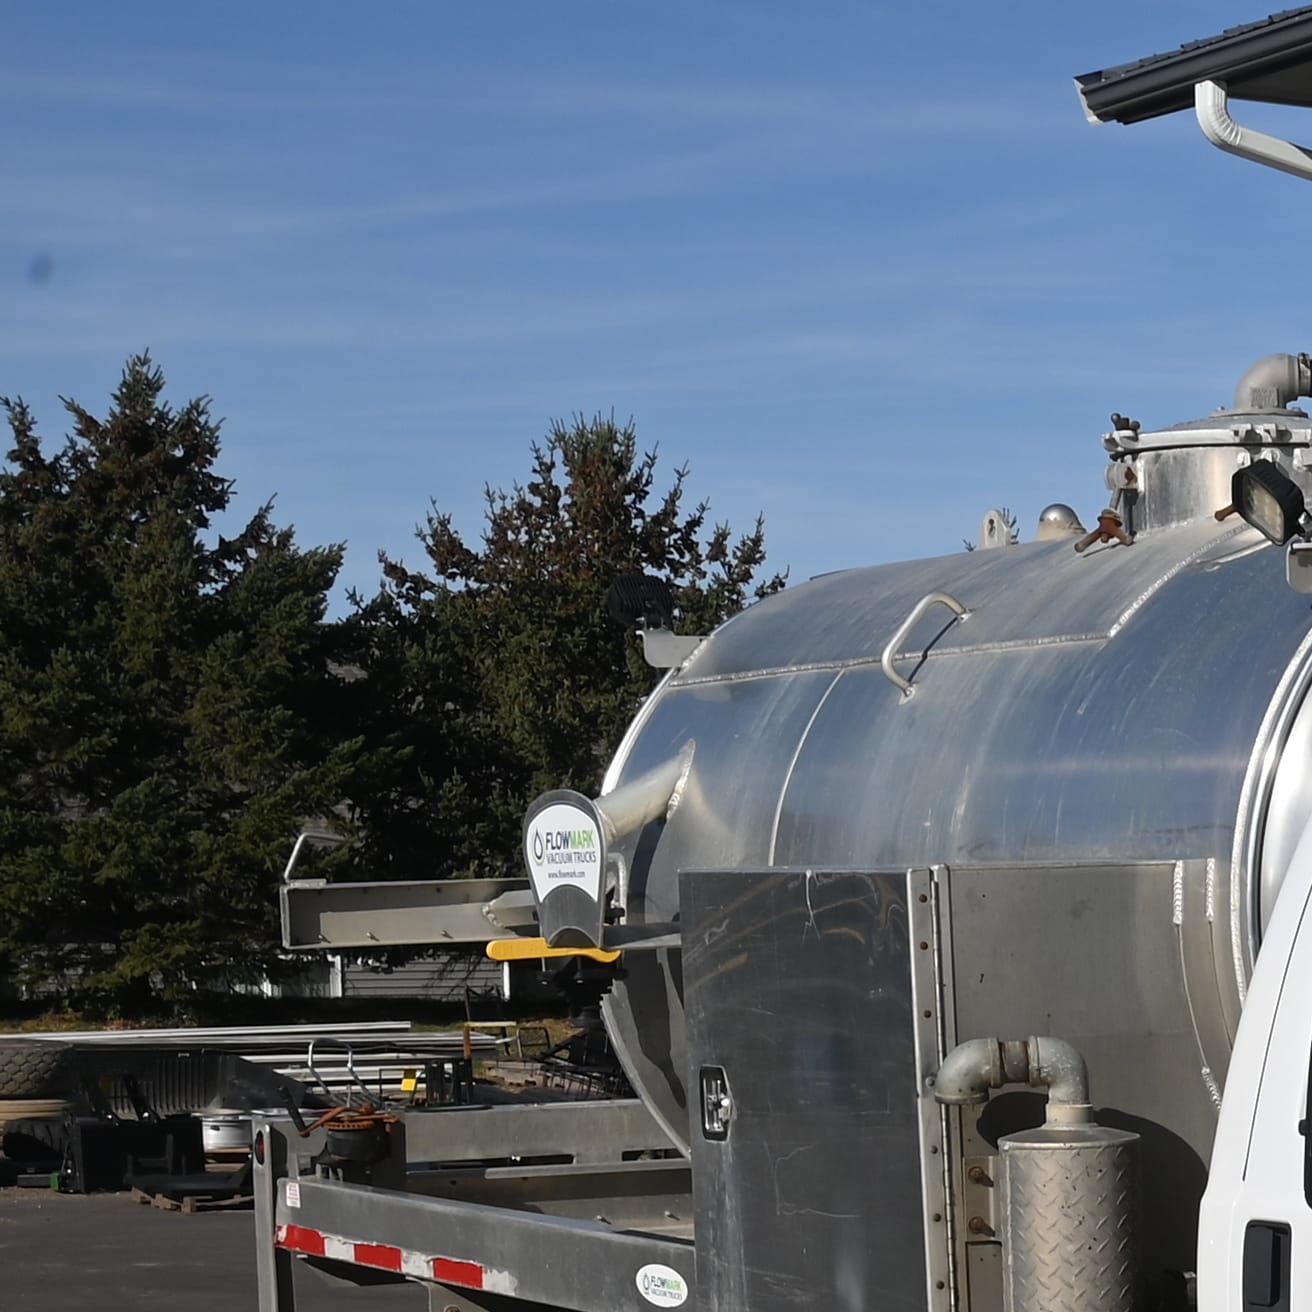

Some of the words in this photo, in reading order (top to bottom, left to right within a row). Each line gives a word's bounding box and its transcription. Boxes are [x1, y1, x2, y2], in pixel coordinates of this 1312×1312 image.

[546, 830, 594, 850] FLOWMARK
[546, 852, 572, 864] VACUUM
[573, 850, 597, 863] TRUCKS
